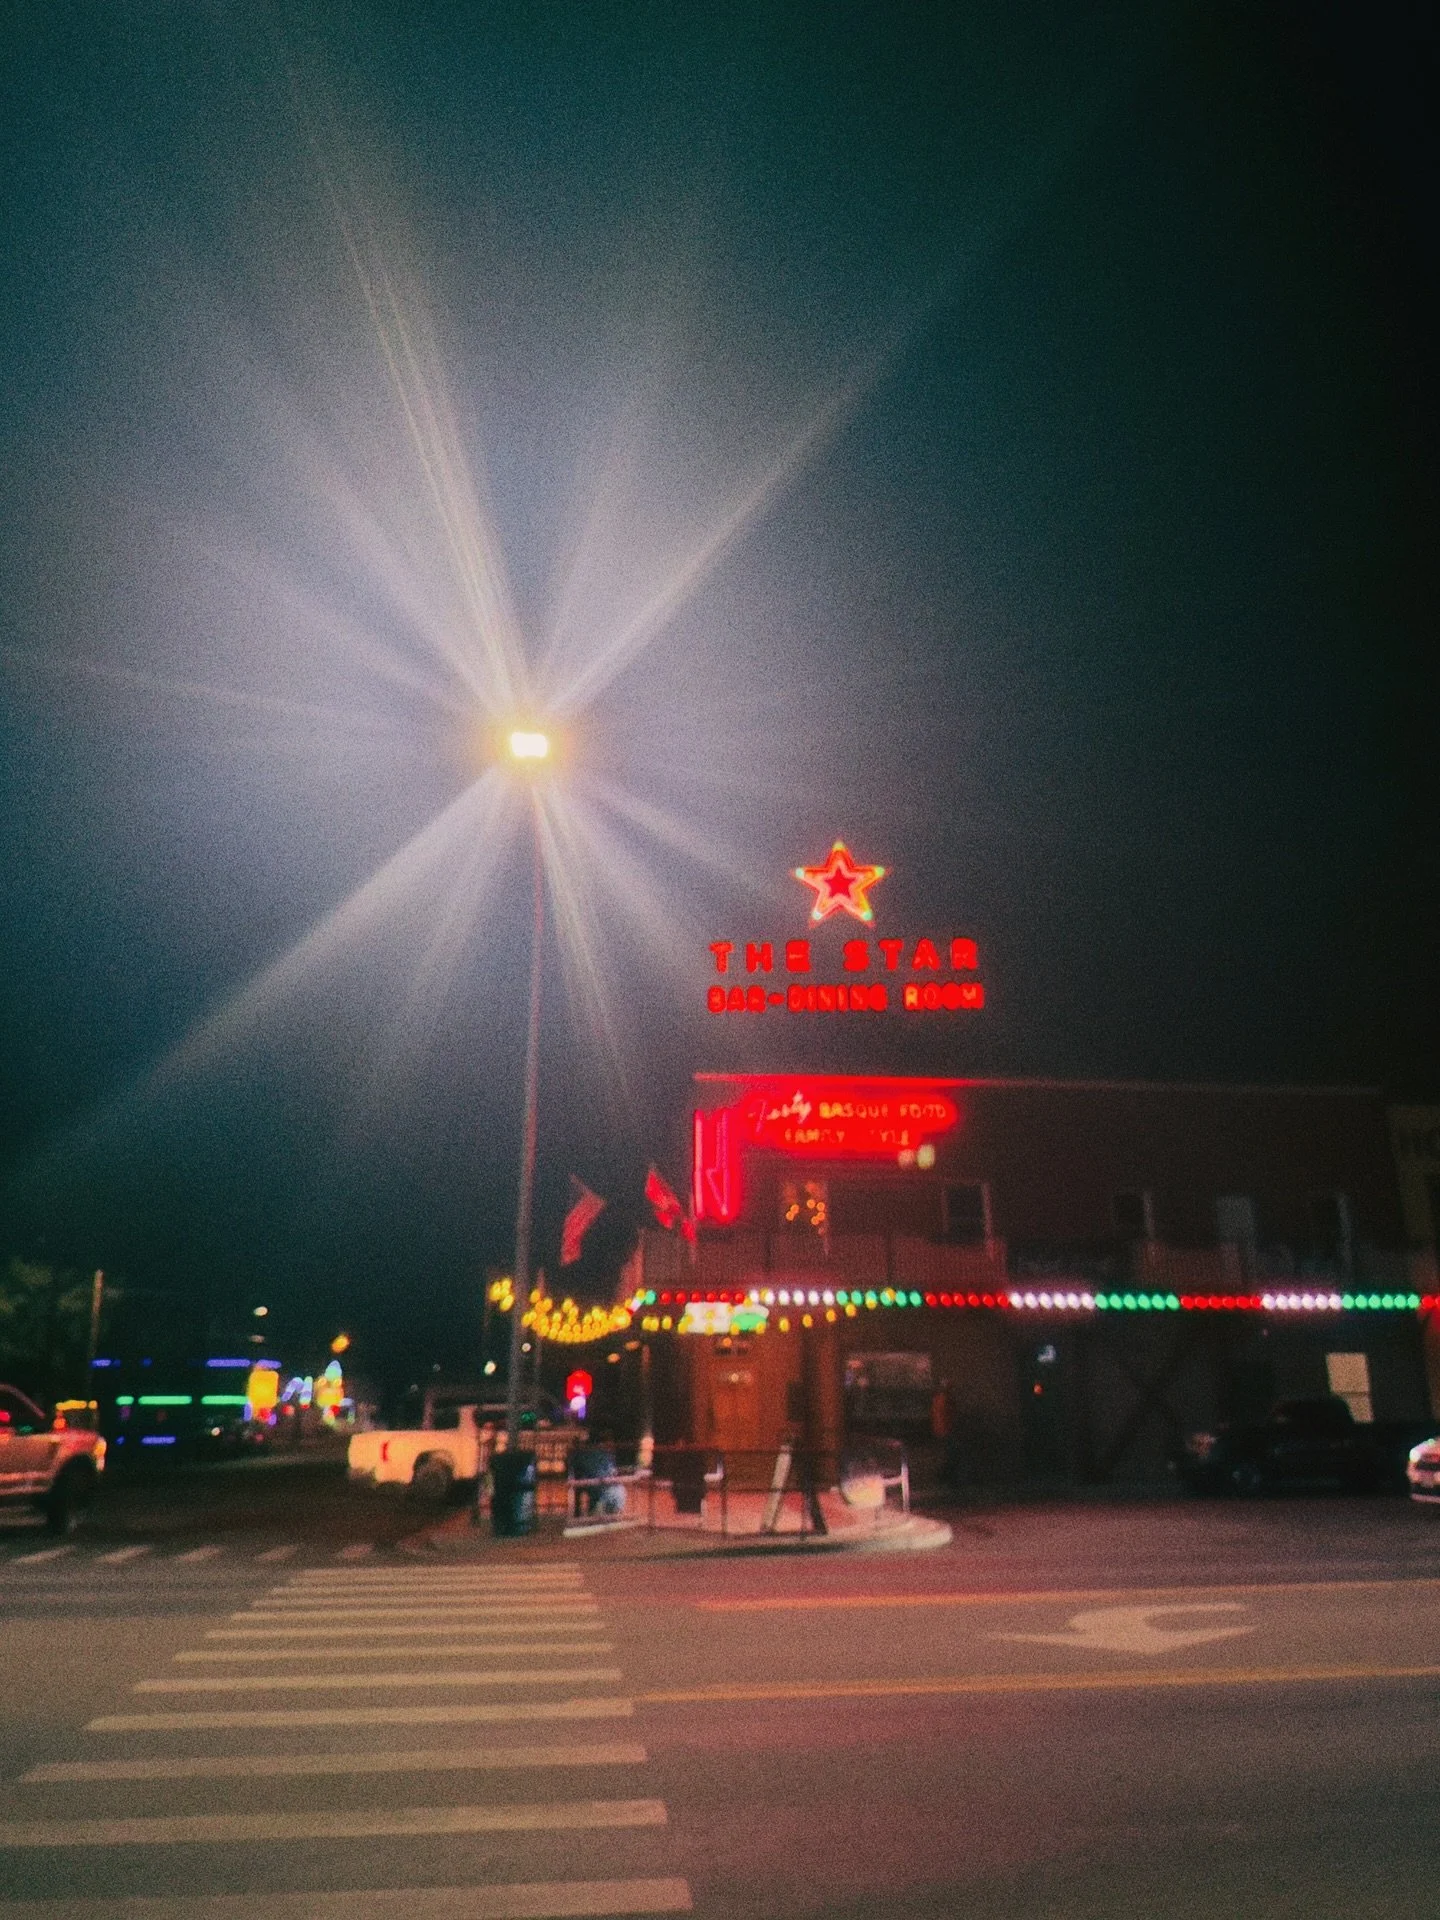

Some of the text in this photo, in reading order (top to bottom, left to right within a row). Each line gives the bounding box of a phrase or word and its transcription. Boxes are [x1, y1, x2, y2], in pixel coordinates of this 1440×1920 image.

[710, 939, 978, 972] THE STAR
[904, 983, 984, 1010] ROOM
[818, 1103, 889, 1119] BASQUE
[899, 1102, 947, 1119] FOOD
